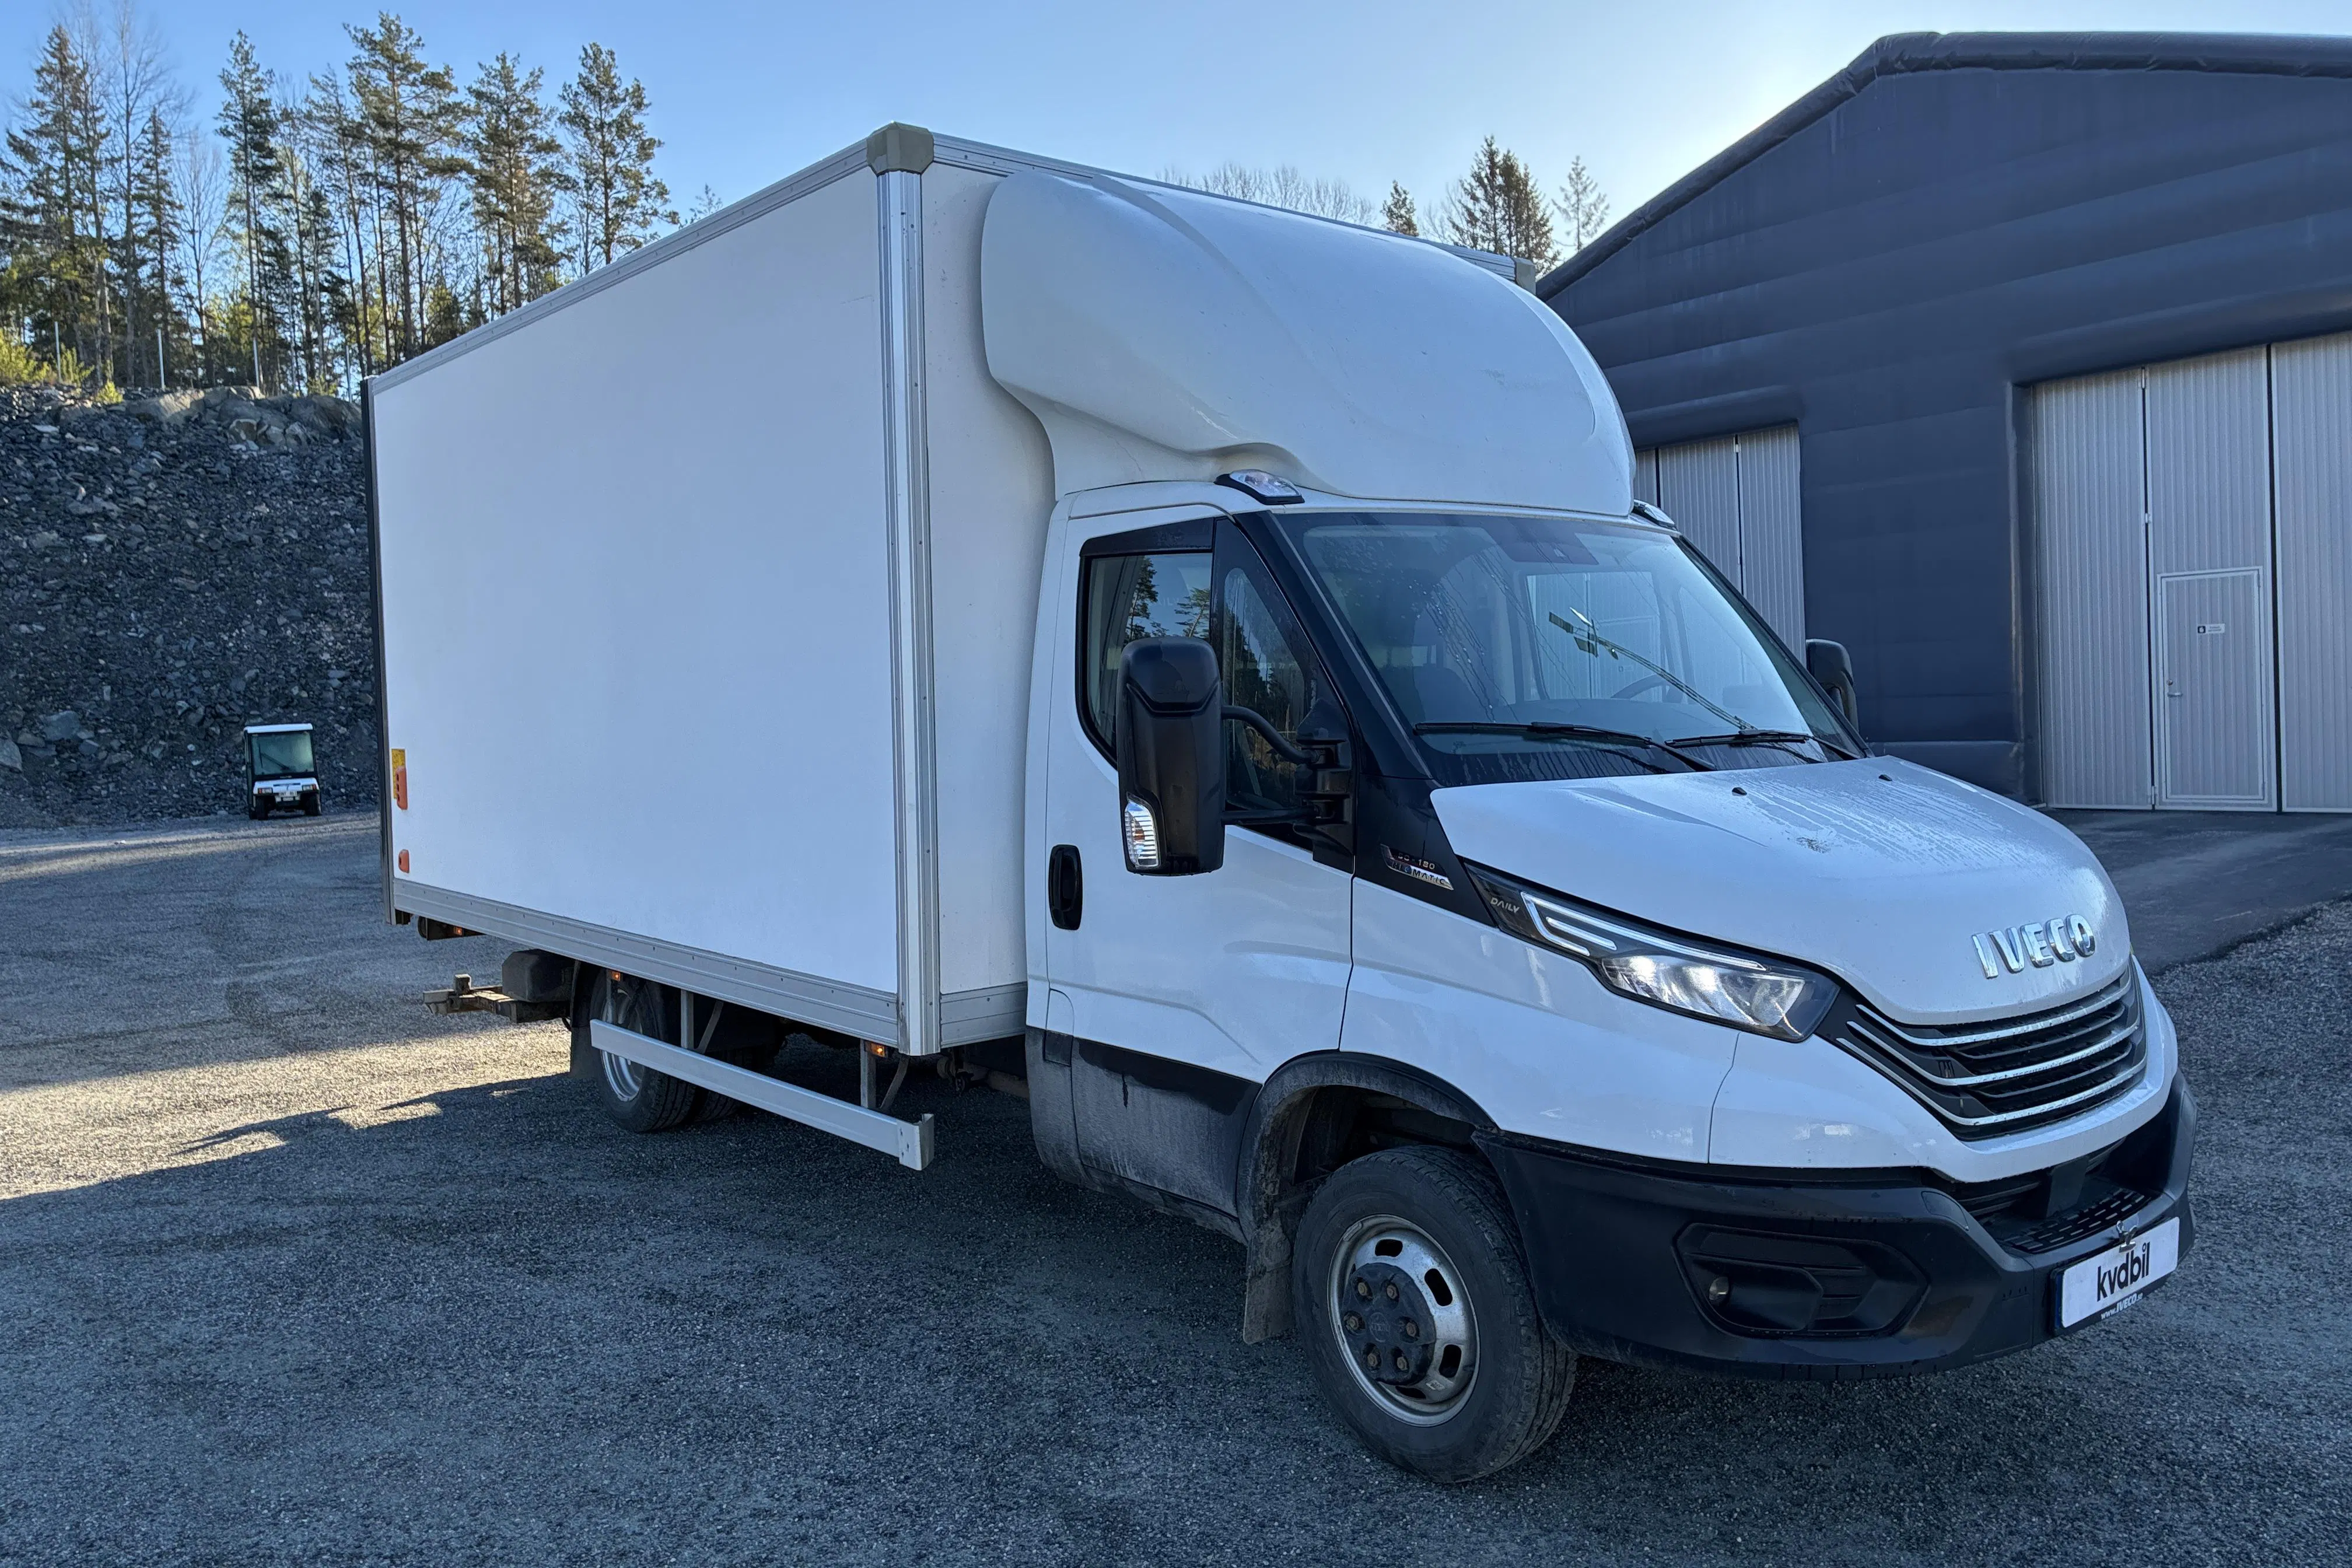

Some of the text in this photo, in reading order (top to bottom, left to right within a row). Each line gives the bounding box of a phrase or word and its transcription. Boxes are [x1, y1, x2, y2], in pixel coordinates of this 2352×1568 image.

[1418, 859, 1436, 870] 180
[1490, 897, 1520, 914] DAILY
[1971, 914, 2096, 979] IVECO
[2096, 1241, 2151, 1302] kvdbil
